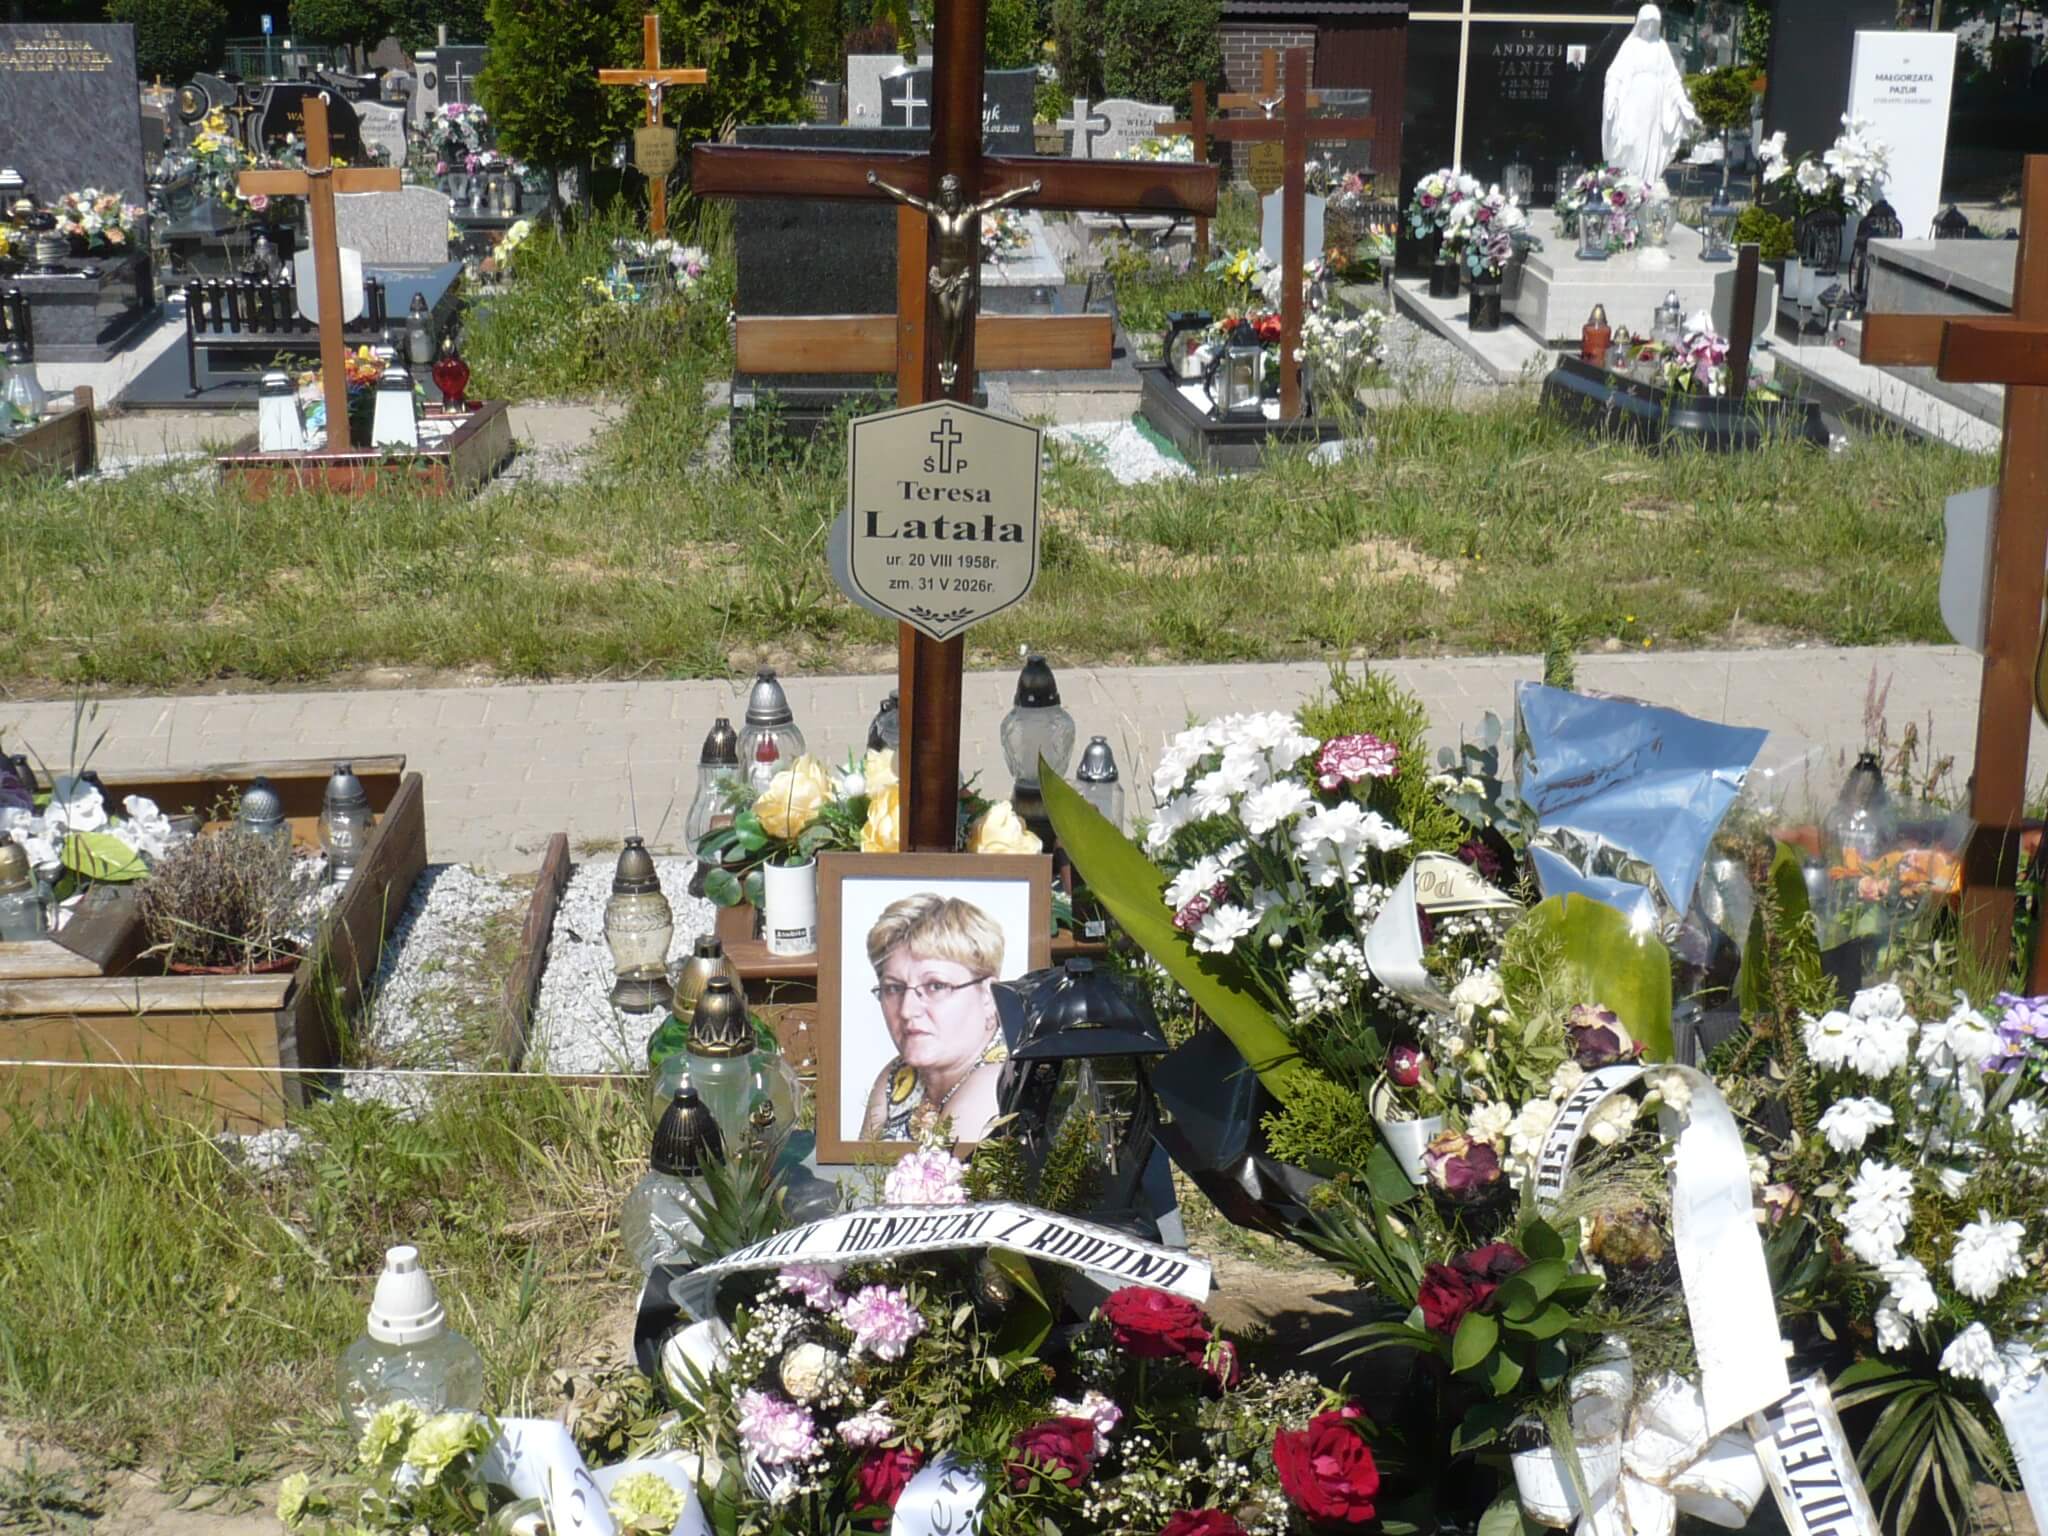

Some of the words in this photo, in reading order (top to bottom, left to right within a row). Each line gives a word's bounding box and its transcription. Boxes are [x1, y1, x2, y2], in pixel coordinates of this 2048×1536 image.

[1492, 43, 1562, 56] ANDRZEJ
[1875, 73, 1933, 81] MAŁGORZATA
[897, 480, 991, 503] Teresa
[862, 510, 1024, 543] Latała
[909, 553, 925, 566] 20
[930, 553, 952, 567] VIII
[958, 555, 999, 569] 1958r.
[918, 577, 933, 590] 31
[939, 578, 949, 591] V
[836, 1210, 995, 1252] AGNIESZKI
[995, 1213, 1034, 1242] Z
